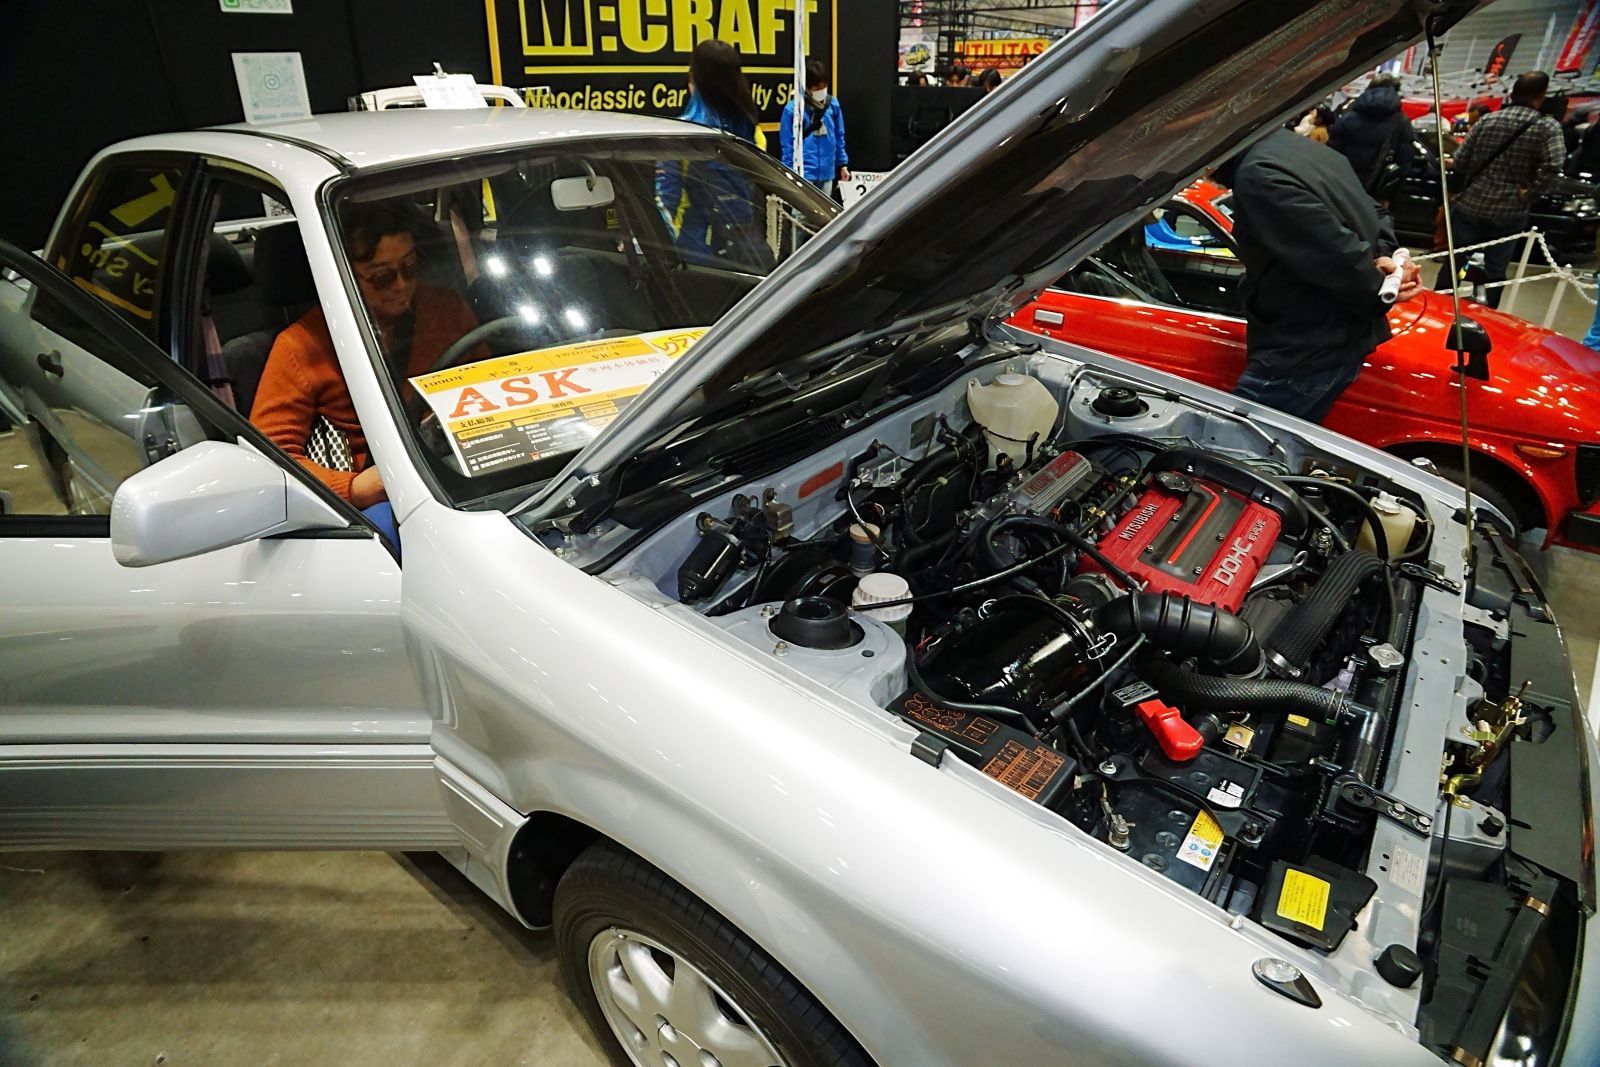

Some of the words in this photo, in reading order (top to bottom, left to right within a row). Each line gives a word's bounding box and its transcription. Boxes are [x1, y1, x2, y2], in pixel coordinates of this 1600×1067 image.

[524, 83, 646, 110] Neoclassic
[652, 82, 687, 108] Car
[448, 368, 592, 418] ASK
[1119, 503, 1159, 541] MITSUBISHI
[1212, 536, 1252, 586] DOHC
